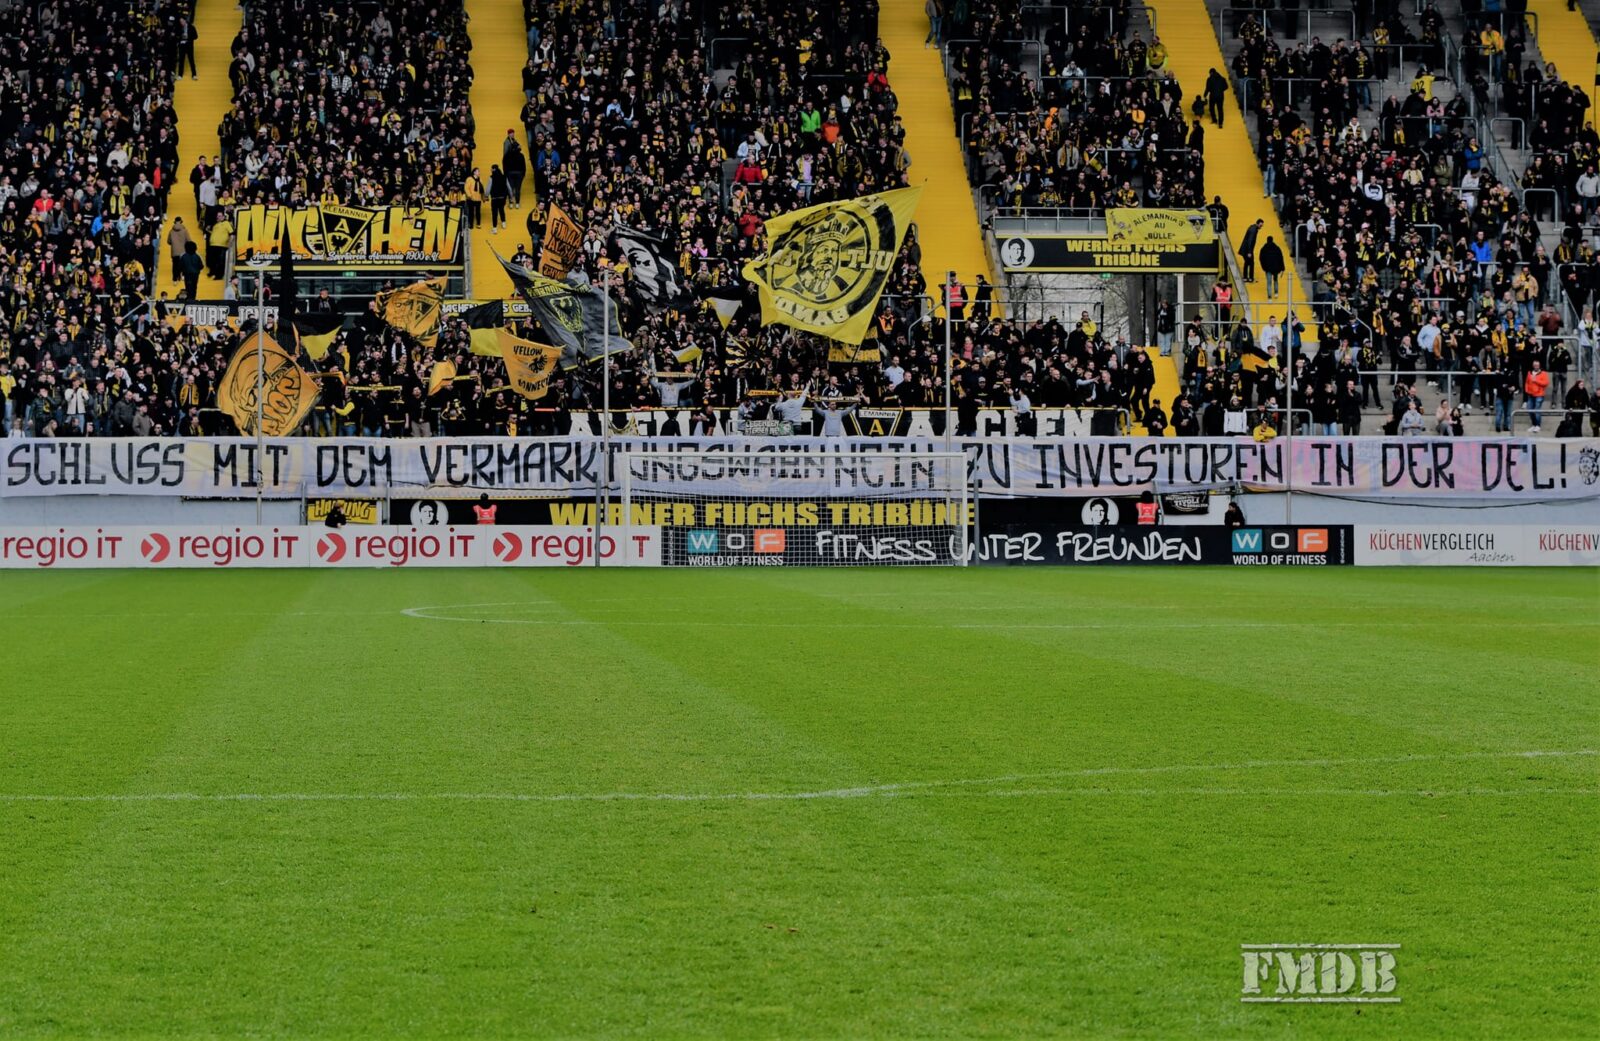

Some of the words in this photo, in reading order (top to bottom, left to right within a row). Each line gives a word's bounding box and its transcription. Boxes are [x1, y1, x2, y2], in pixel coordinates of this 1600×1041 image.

[323, 204, 369, 219] ALEMANNIA
[406, 250, 424, 261] 1900
[1066, 240, 1132, 252] WERNER
[1093, 252, 1160, 266] TRIBÜNE
[513, 345, 543, 357] YELLOW
[7, 442, 185, 487] SCHLUSS
[213, 443, 288, 487] MIT
[316, 445, 393, 487] DEM
[961, 442, 1012, 489] ZU
[1032, 443, 1283, 489] INVESTOREN
[1311, 442, 1354, 486] IN
[1382, 442, 1454, 489] DER
[1481, 442, 1567, 491] DEL!
[314, 499, 370, 519] HAUNG
[550, 502, 696, 526] WERNER
[705, 502, 819, 526] FUCHS
[826, 498, 975, 526] TRIBÜNE
[3, 528, 88, 567] regio
[179, 528, 265, 566] regio
[355, 527, 441, 566] regio
[531, 527, 616, 566] regio
[815, 530, 937, 561] FITNESS
[949, 533, 1045, 562] UNTER
[1056, 531, 1202, 562] FREUNDEN
[1369, 529, 1495, 551] KÜCHENVERGLEICH
[688, 555, 724, 566] WORLD
[726, 555, 740, 566] OF
[742, 555, 784, 566] FITNESS
[1232, 554, 1268, 565] WORLD
[1270, 554, 1284, 565] OF
[1286, 554, 1327, 565] FITNESS
[1467, 551, 1517, 563] Aachen
